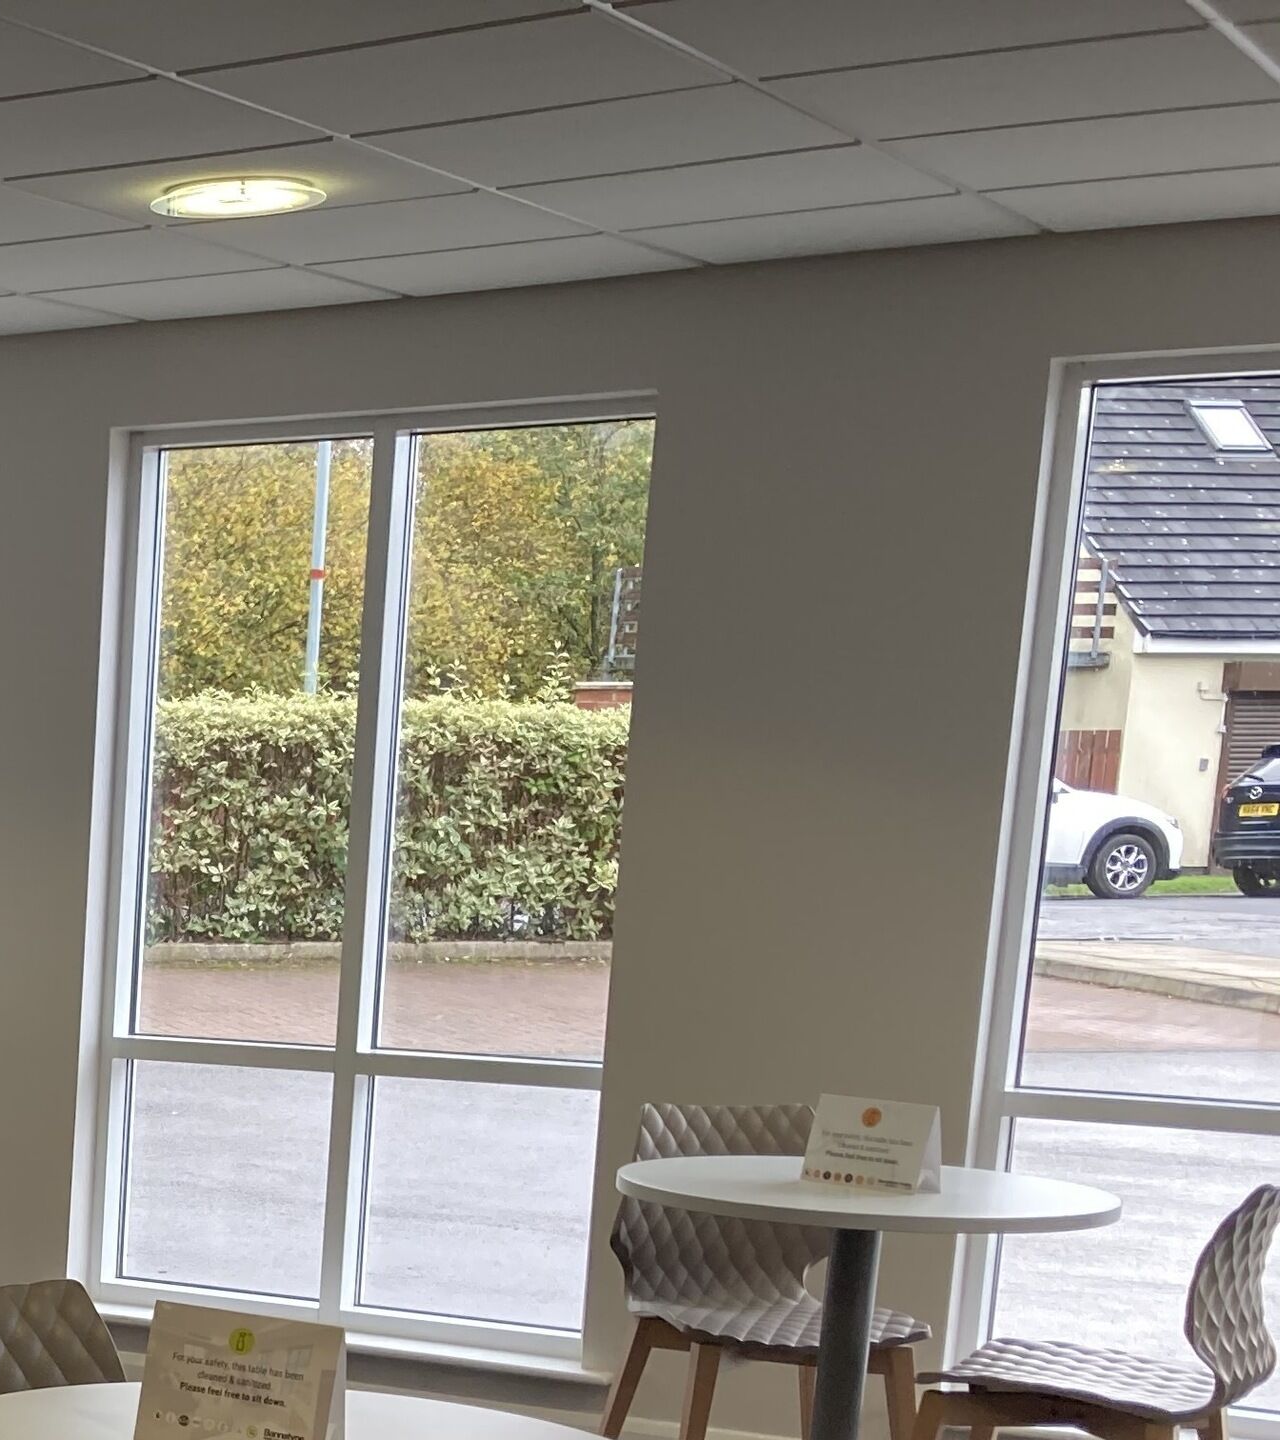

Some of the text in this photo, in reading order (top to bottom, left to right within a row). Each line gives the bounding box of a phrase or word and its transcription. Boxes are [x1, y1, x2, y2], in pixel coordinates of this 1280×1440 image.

[186, 1355, 202, 1365] your
[231, 1361, 246, 1372] this
[248, 1364, 267, 1376] table
[269, 1367, 282, 1378] has
[284, 1369, 304, 1381] been
[197, 1370, 227, 1383] cleaned
[180, 1381, 205, 1394] Please
[207, 1386, 223, 1396] feel
[224, 1389, 240, 1400] free
[241, 1392, 250, 1401] to
[252, 1394, 262, 1404] sit
